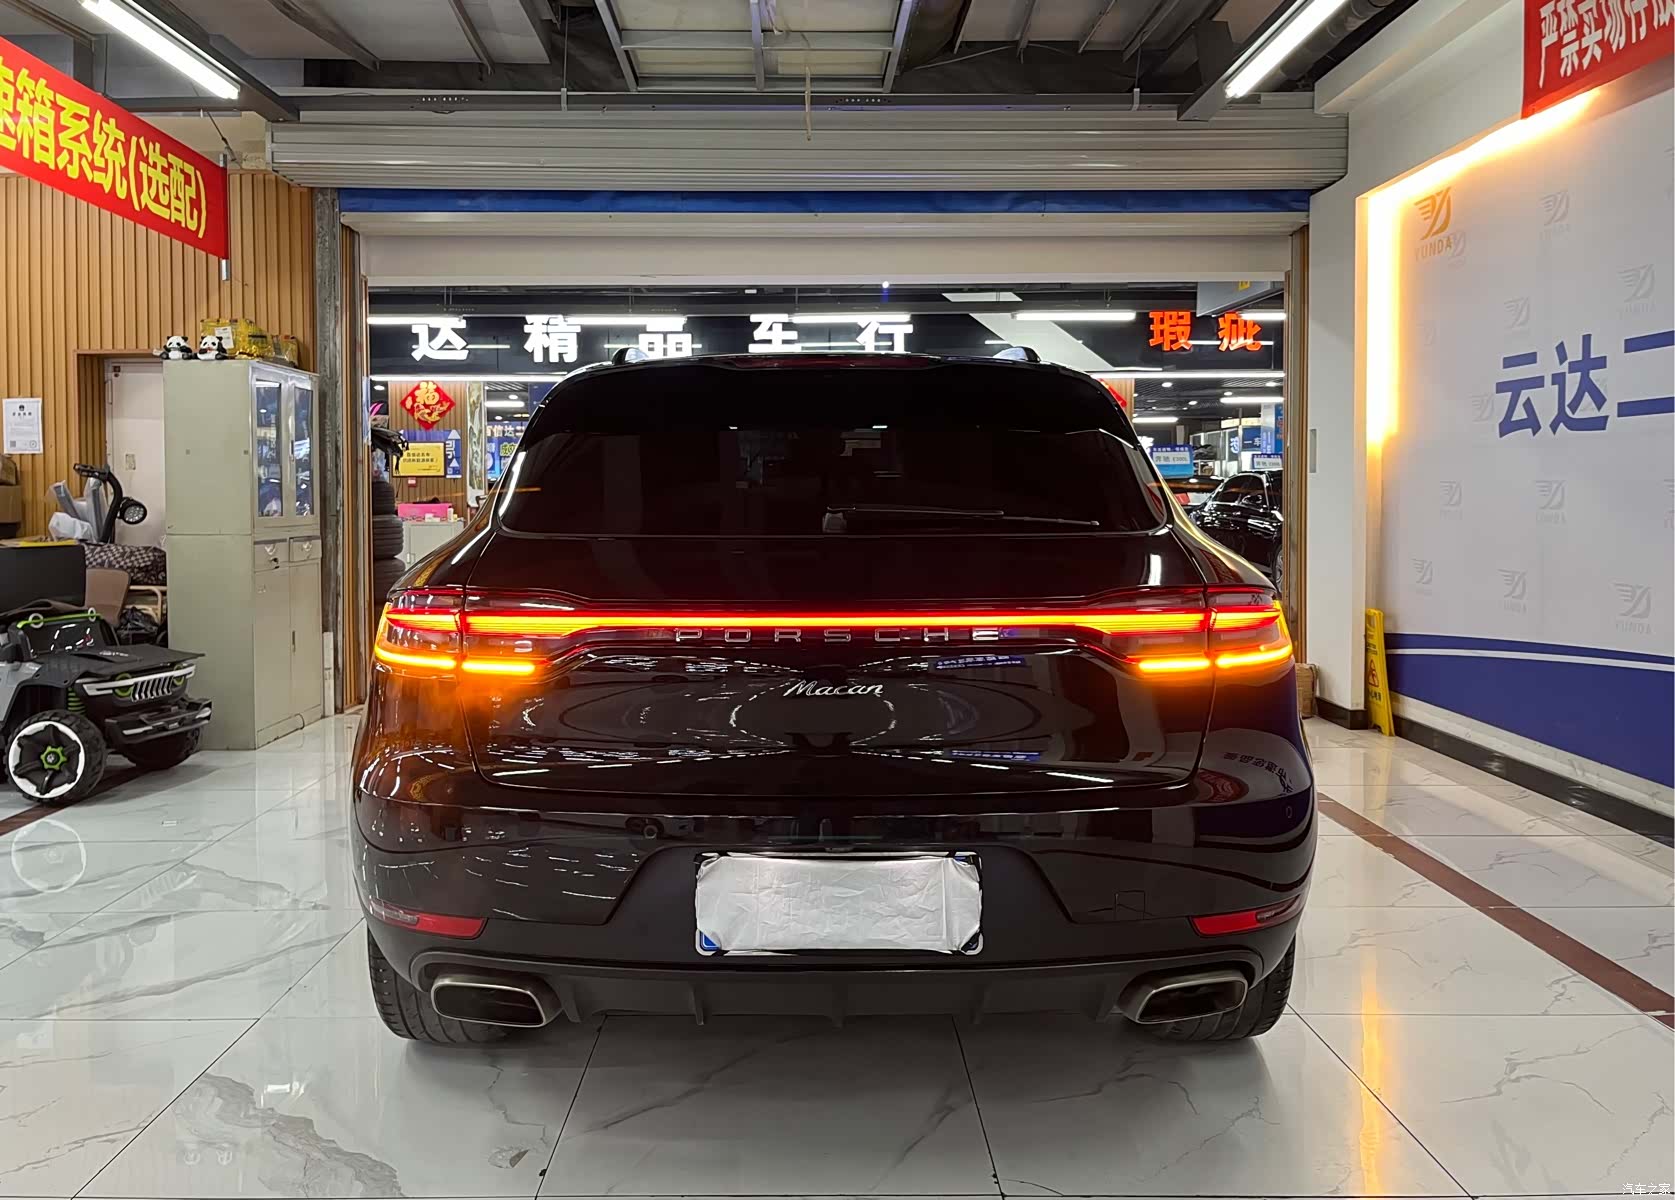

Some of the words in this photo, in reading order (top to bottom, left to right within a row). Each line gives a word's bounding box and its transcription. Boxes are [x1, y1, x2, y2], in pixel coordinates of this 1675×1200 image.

[1415, 236, 1452, 262] YUNDA
[1149, 310, 1263, 352] 瑕疵
[1496, 330, 1675, 438] 云达二
[675, 628, 999, 643] PORSCHE
[783, 679, 884, 697] Macan
